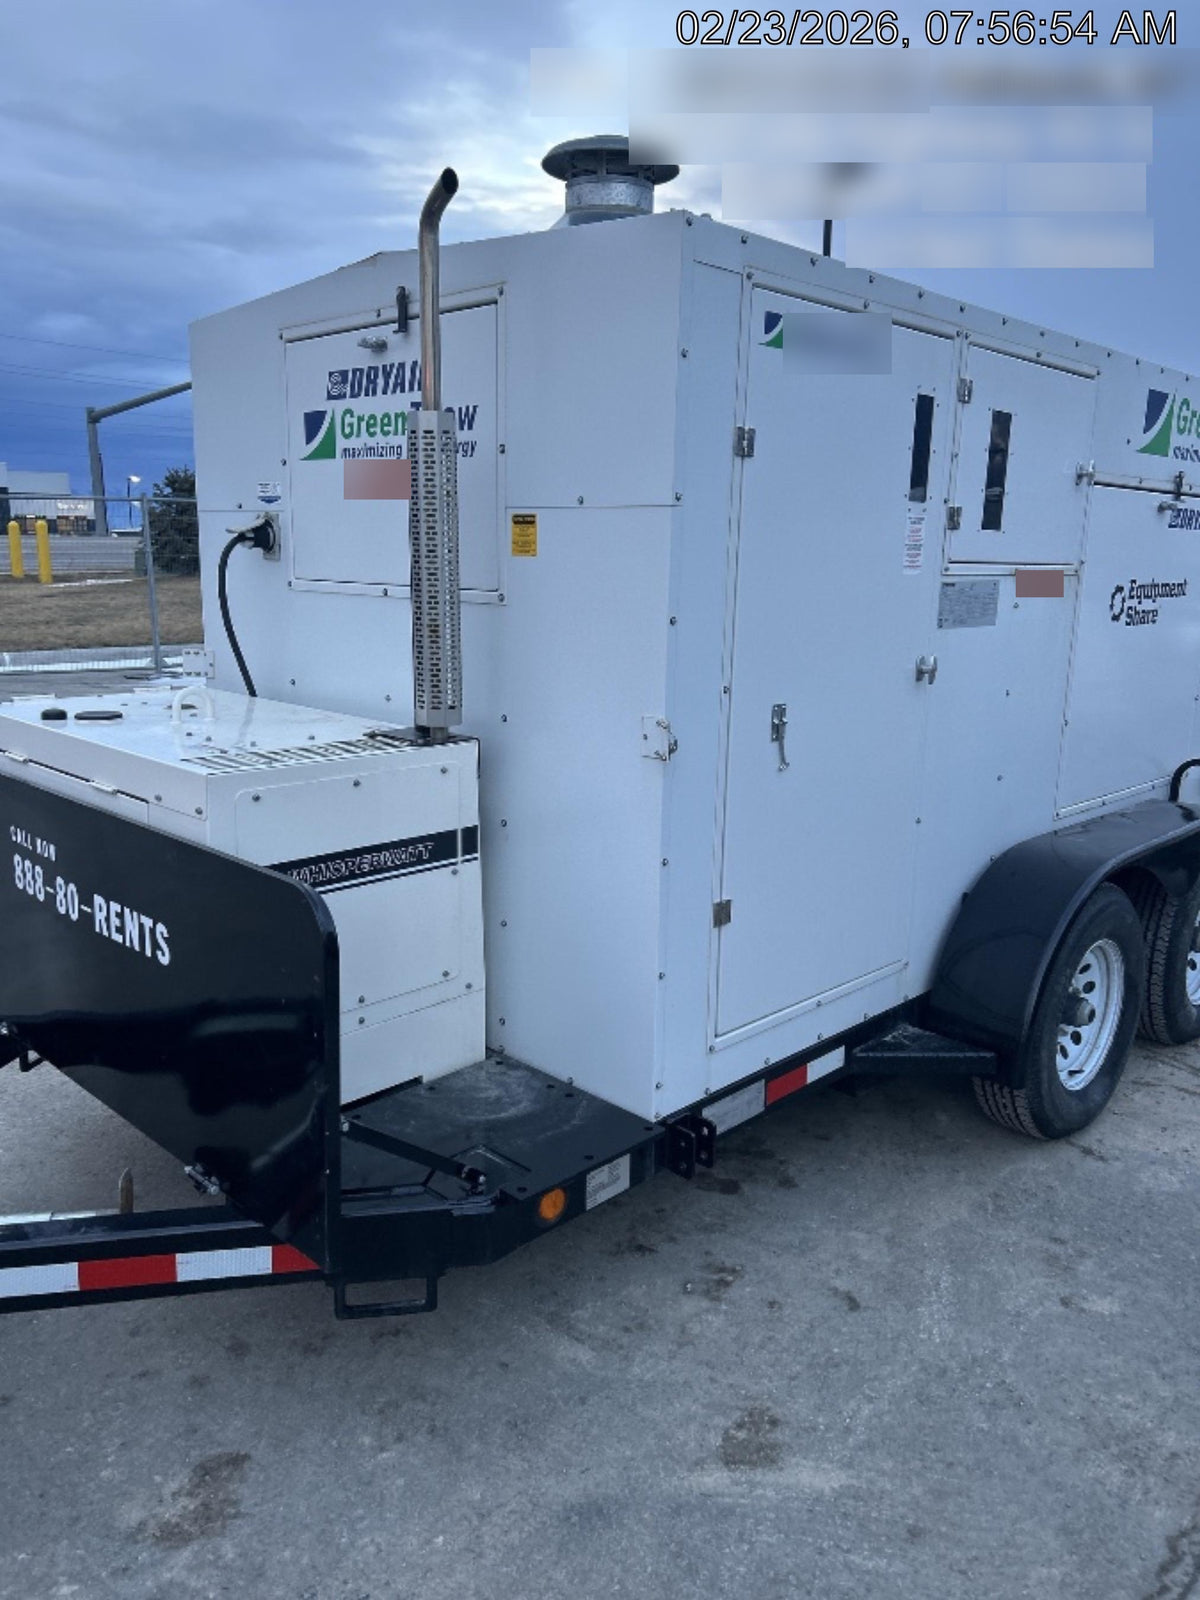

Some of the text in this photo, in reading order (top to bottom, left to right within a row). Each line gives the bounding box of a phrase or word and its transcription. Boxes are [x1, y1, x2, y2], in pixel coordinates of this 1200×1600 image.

[349, 359, 421, 398] DRYAI
[341, 442, 403, 459] maximizing
[1128, 578, 1187, 604] Equipment
[1125, 606, 1158, 626] Share
[9, 825, 56, 861] CALL NOW
[13, 853, 171, 966] 888-80-RENTS
